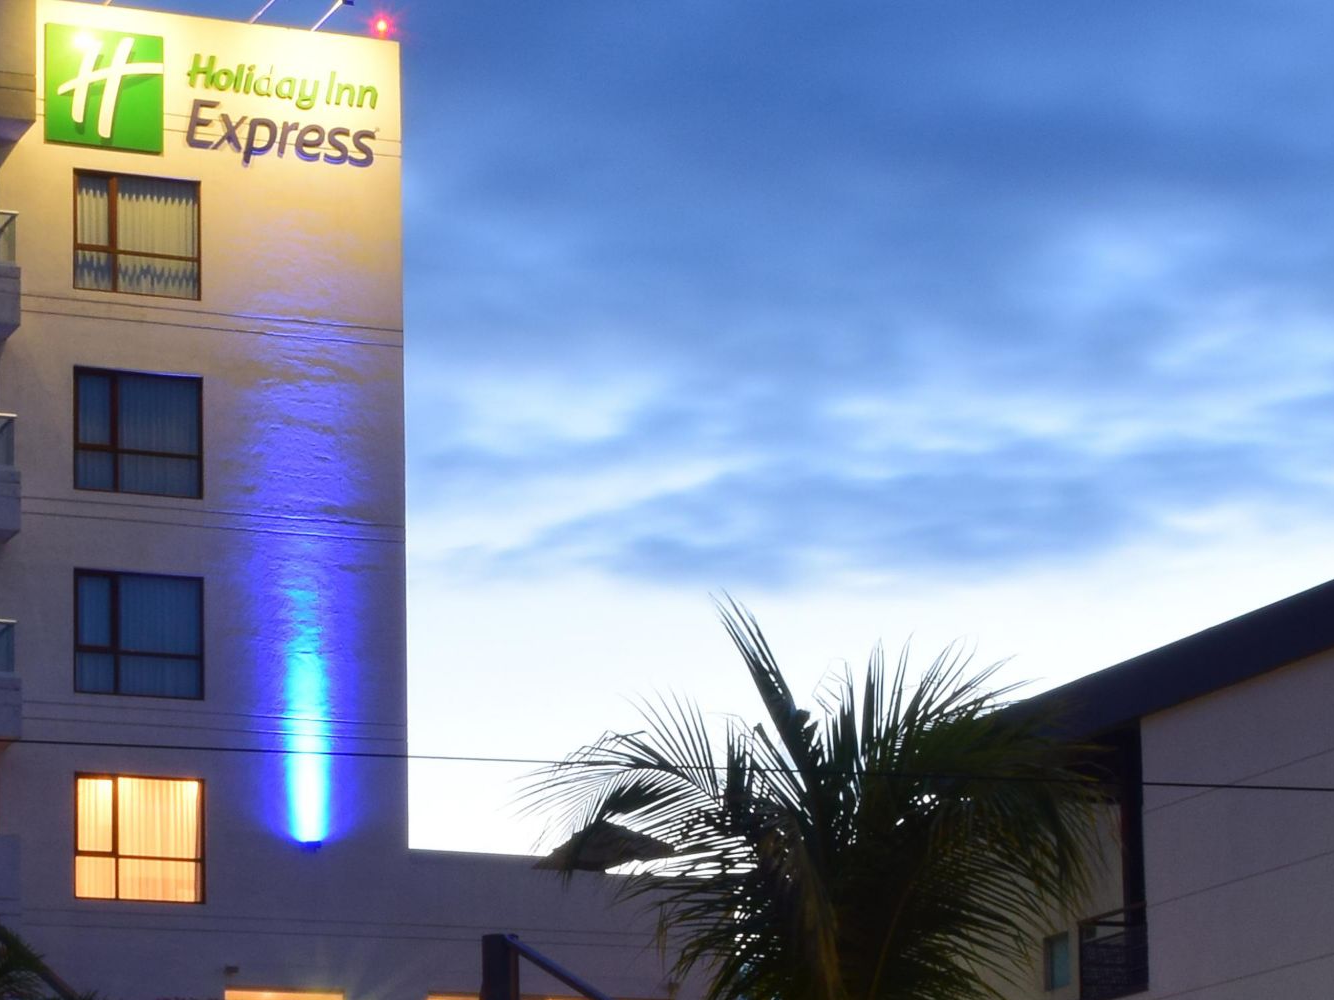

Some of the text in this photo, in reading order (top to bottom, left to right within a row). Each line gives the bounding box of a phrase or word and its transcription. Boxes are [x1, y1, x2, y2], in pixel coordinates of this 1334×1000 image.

[186, 53, 379, 110] Holiday Inn
[185, 98, 377, 168] Express
